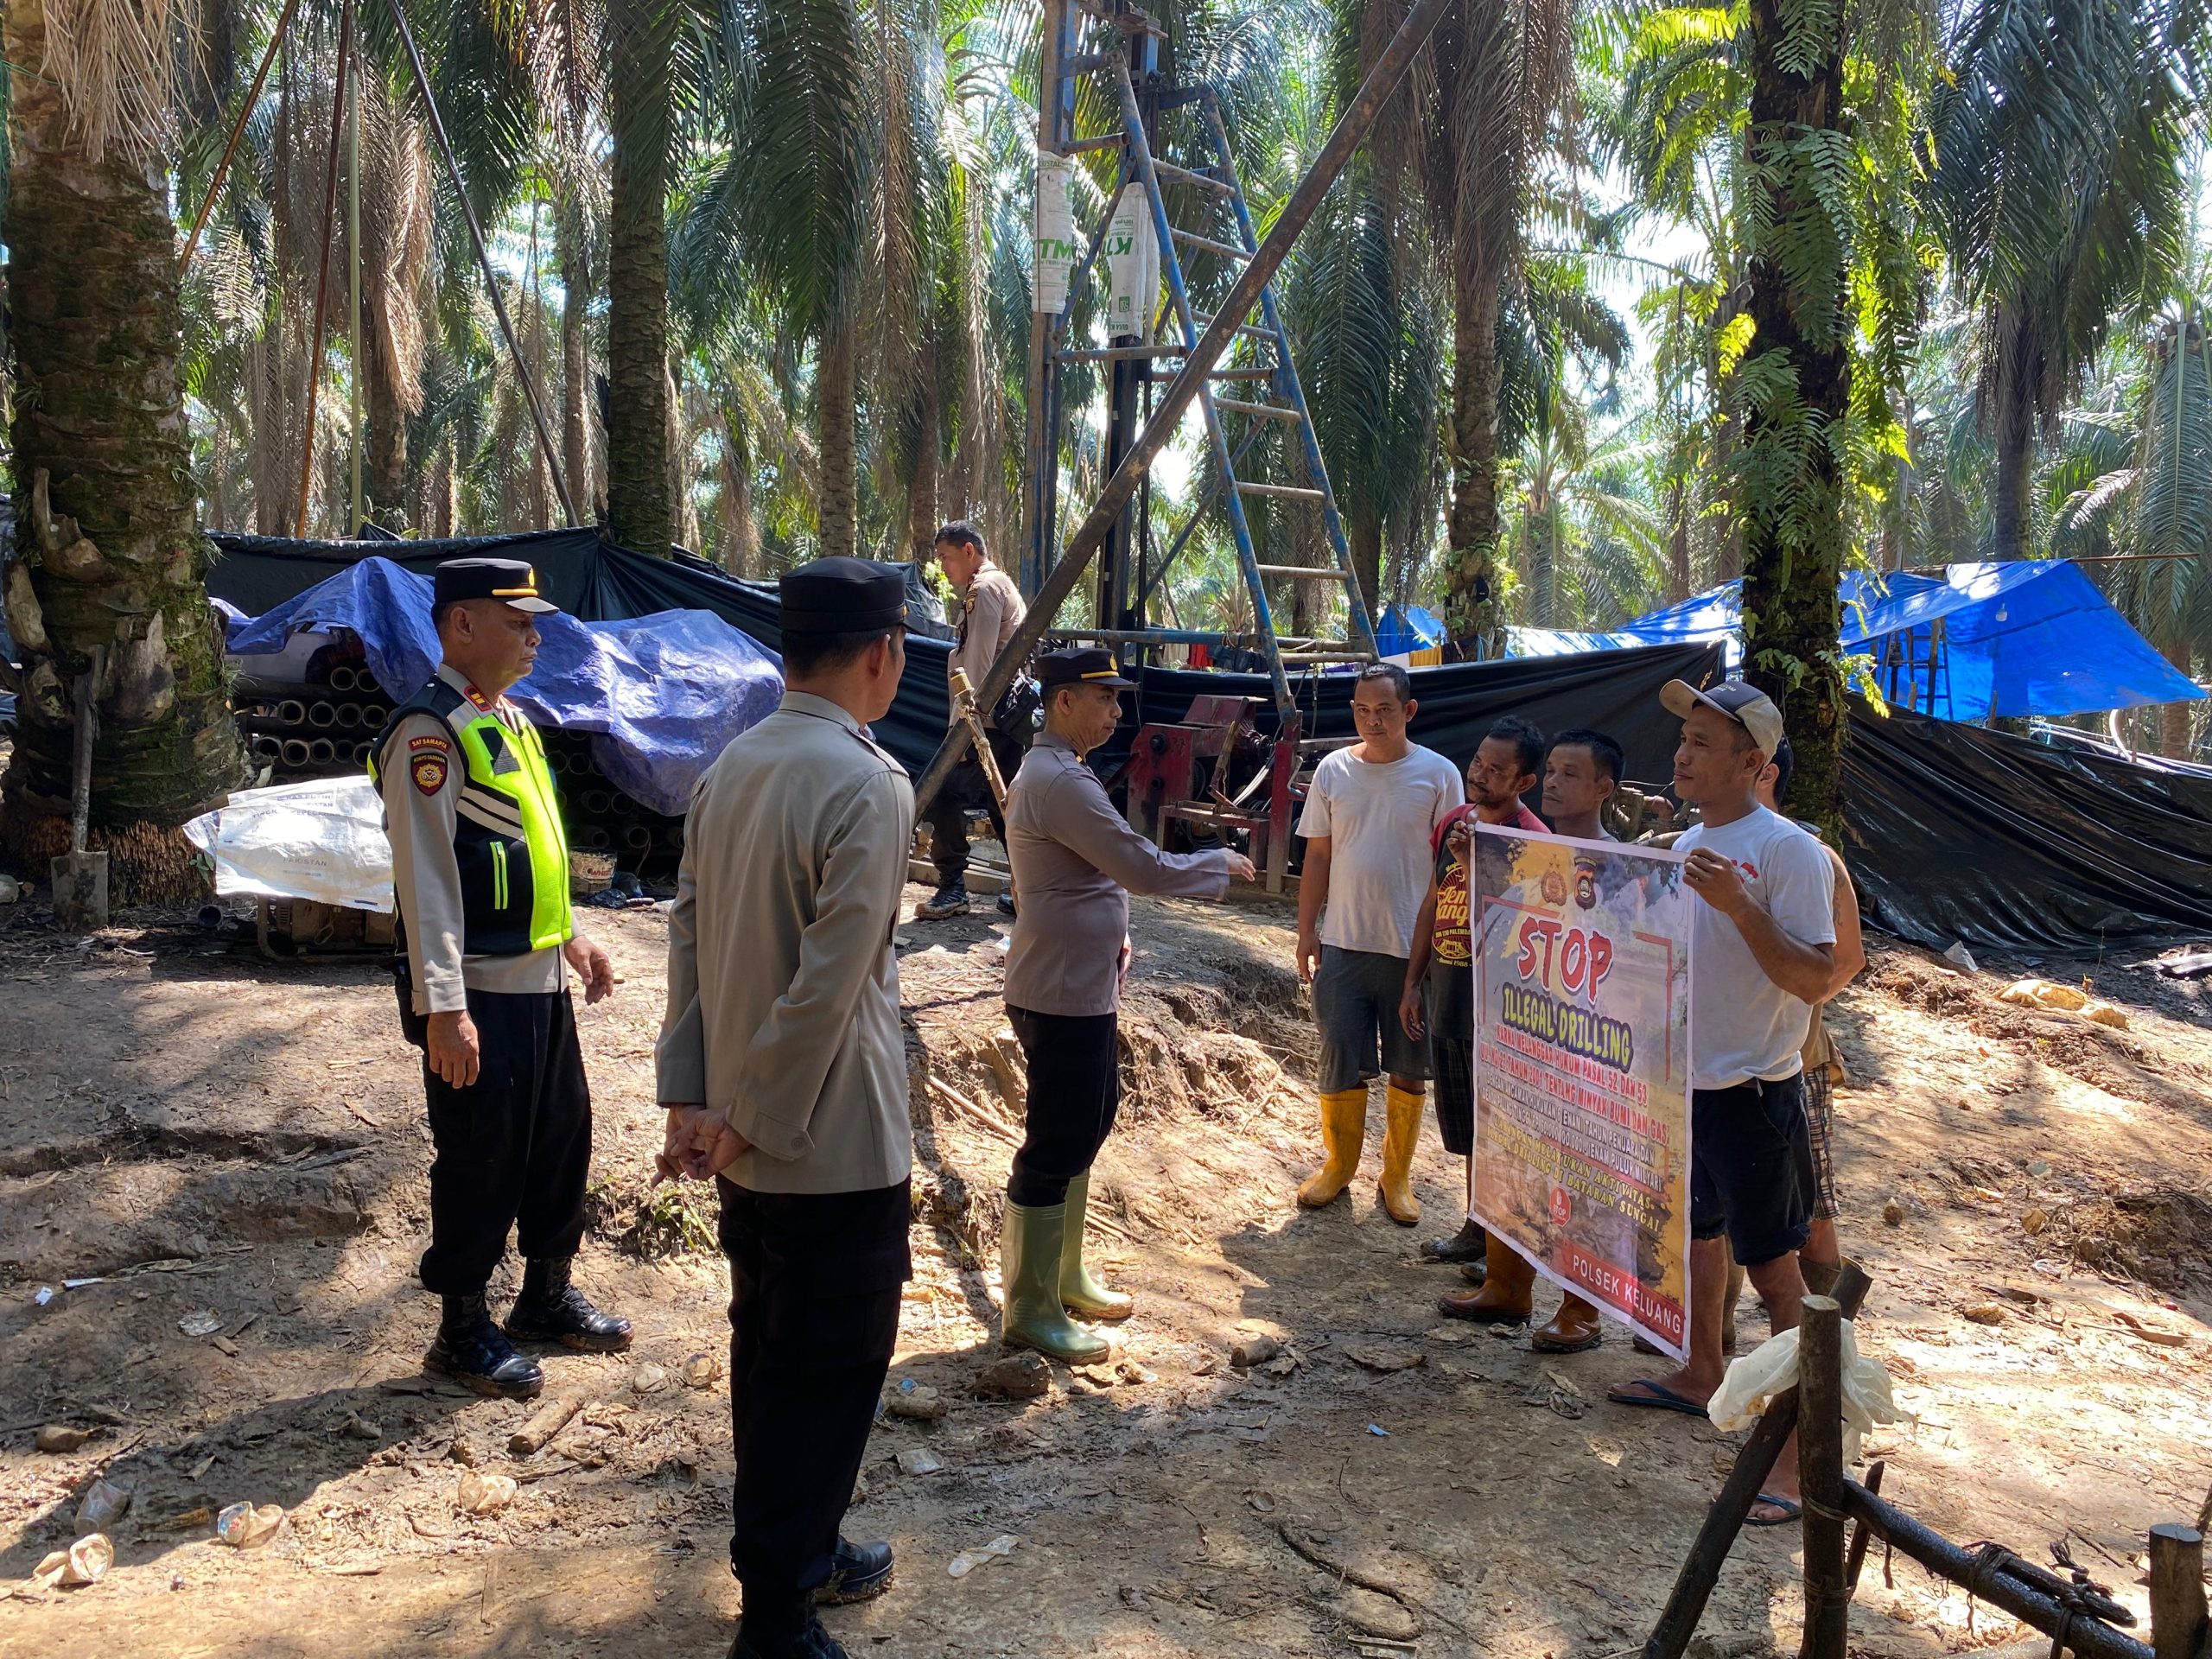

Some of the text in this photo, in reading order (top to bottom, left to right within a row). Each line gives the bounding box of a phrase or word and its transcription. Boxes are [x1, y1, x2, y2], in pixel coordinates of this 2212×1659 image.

[1518, 916, 1613, 1005] STOP
[1503, 987, 1631, 1068] ILLEGAL DRILLING
[1545, 1071, 1577, 1105] TENTANG
[1578, 1086, 1608, 1121] MINYAK
[1609, 1100, 1631, 1129] BUMI
[1631, 1109, 1649, 1137] DAN
[1555, 1048, 1580, 1077] HUKUM
[1583, 1059, 1606, 1088] PASAL
[1608, 1071, 1618, 1094] 52
[1620, 1074, 1636, 1100] DAN
[1637, 1081, 1648, 1106] 53
[1535, 1137, 1592, 1178] MELAKUKAN
[1585, 1119, 1607, 1145] TAHUN
[1641, 1144, 1655, 1166] DAN
[1514, 1143, 1552, 1175] DRILLING
[1553, 1166, 1564, 1183] DI
[1567, 1173, 1616, 1207] BATARAN
[1618, 1199, 1660, 1232] SUNGAI
[1573, 1254, 1681, 1334] POLSEK KELUANG
